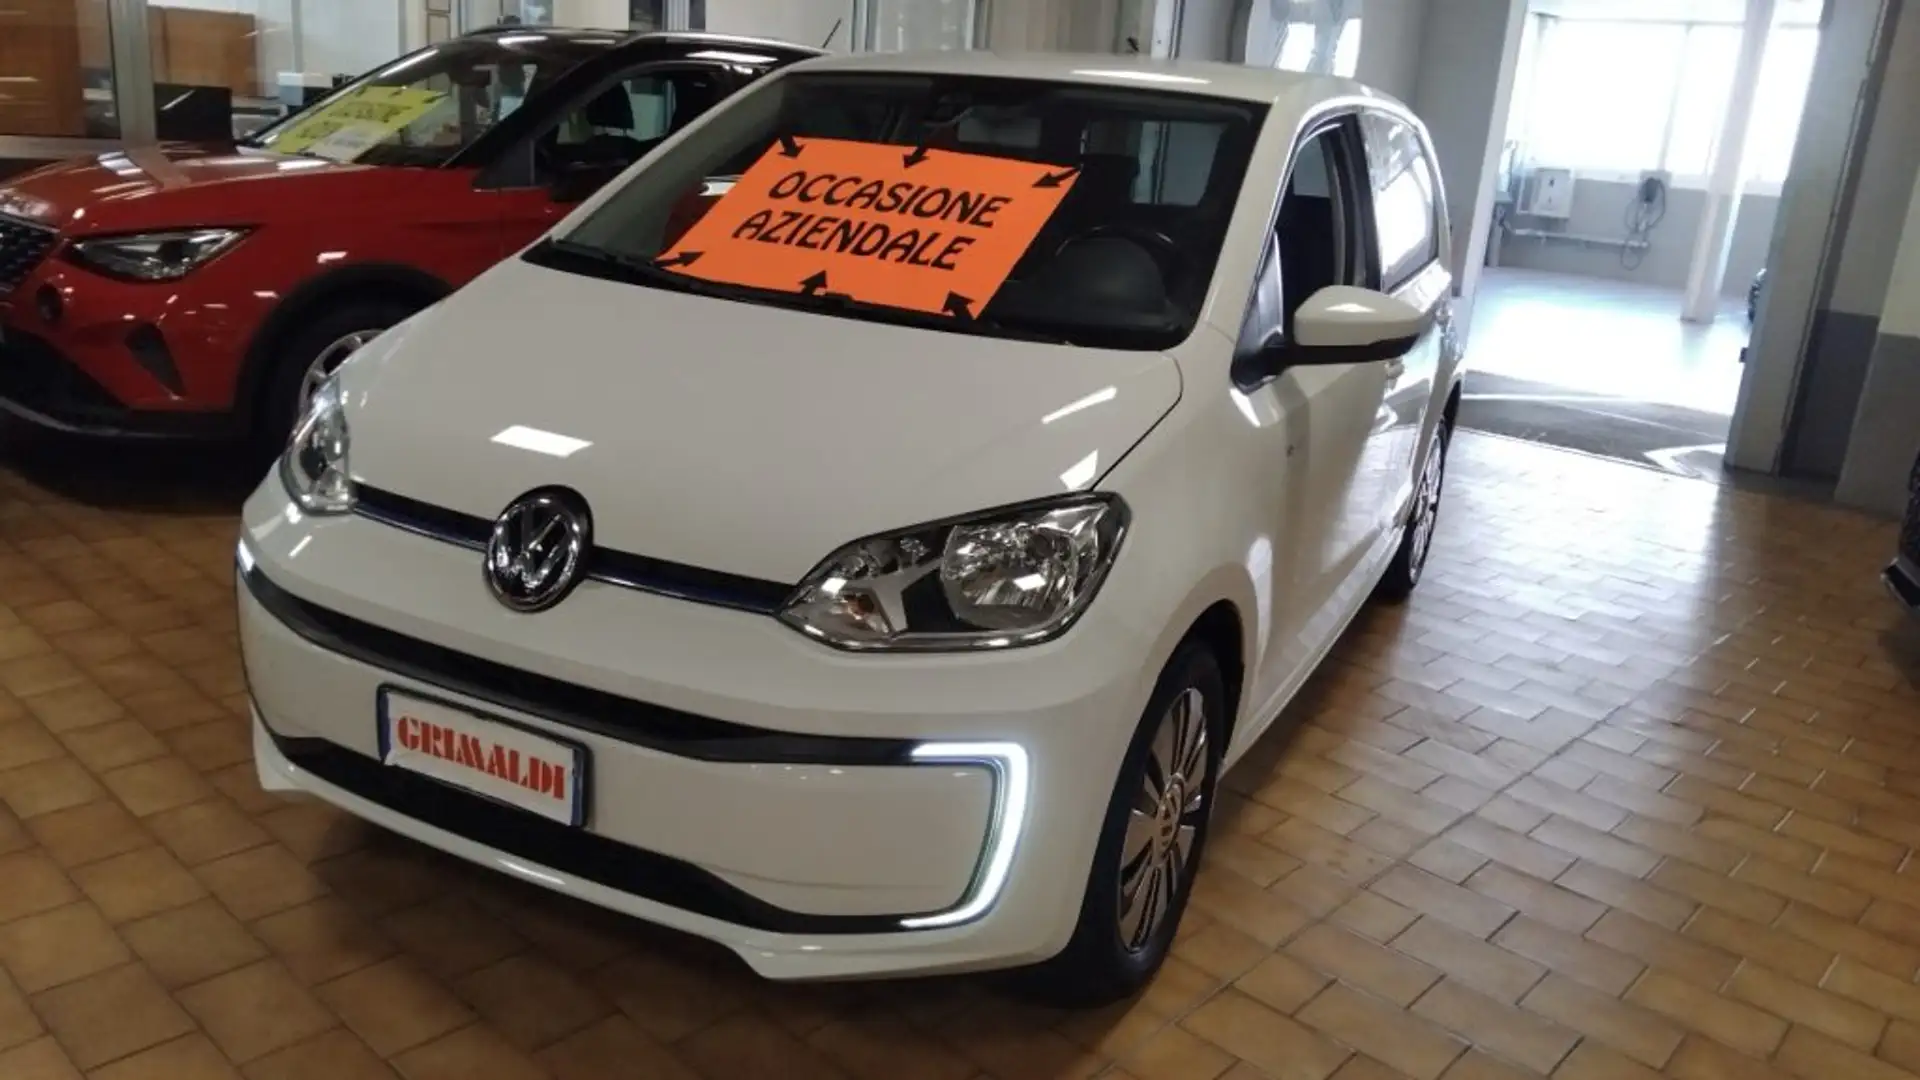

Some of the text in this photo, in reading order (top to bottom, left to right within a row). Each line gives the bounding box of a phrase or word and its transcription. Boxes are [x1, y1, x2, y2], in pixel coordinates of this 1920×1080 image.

[768, 171, 1012, 228] OCCASIONE
[731, 209, 976, 271] AZIENDALE
[397, 715, 565, 800] GRIMALDI
